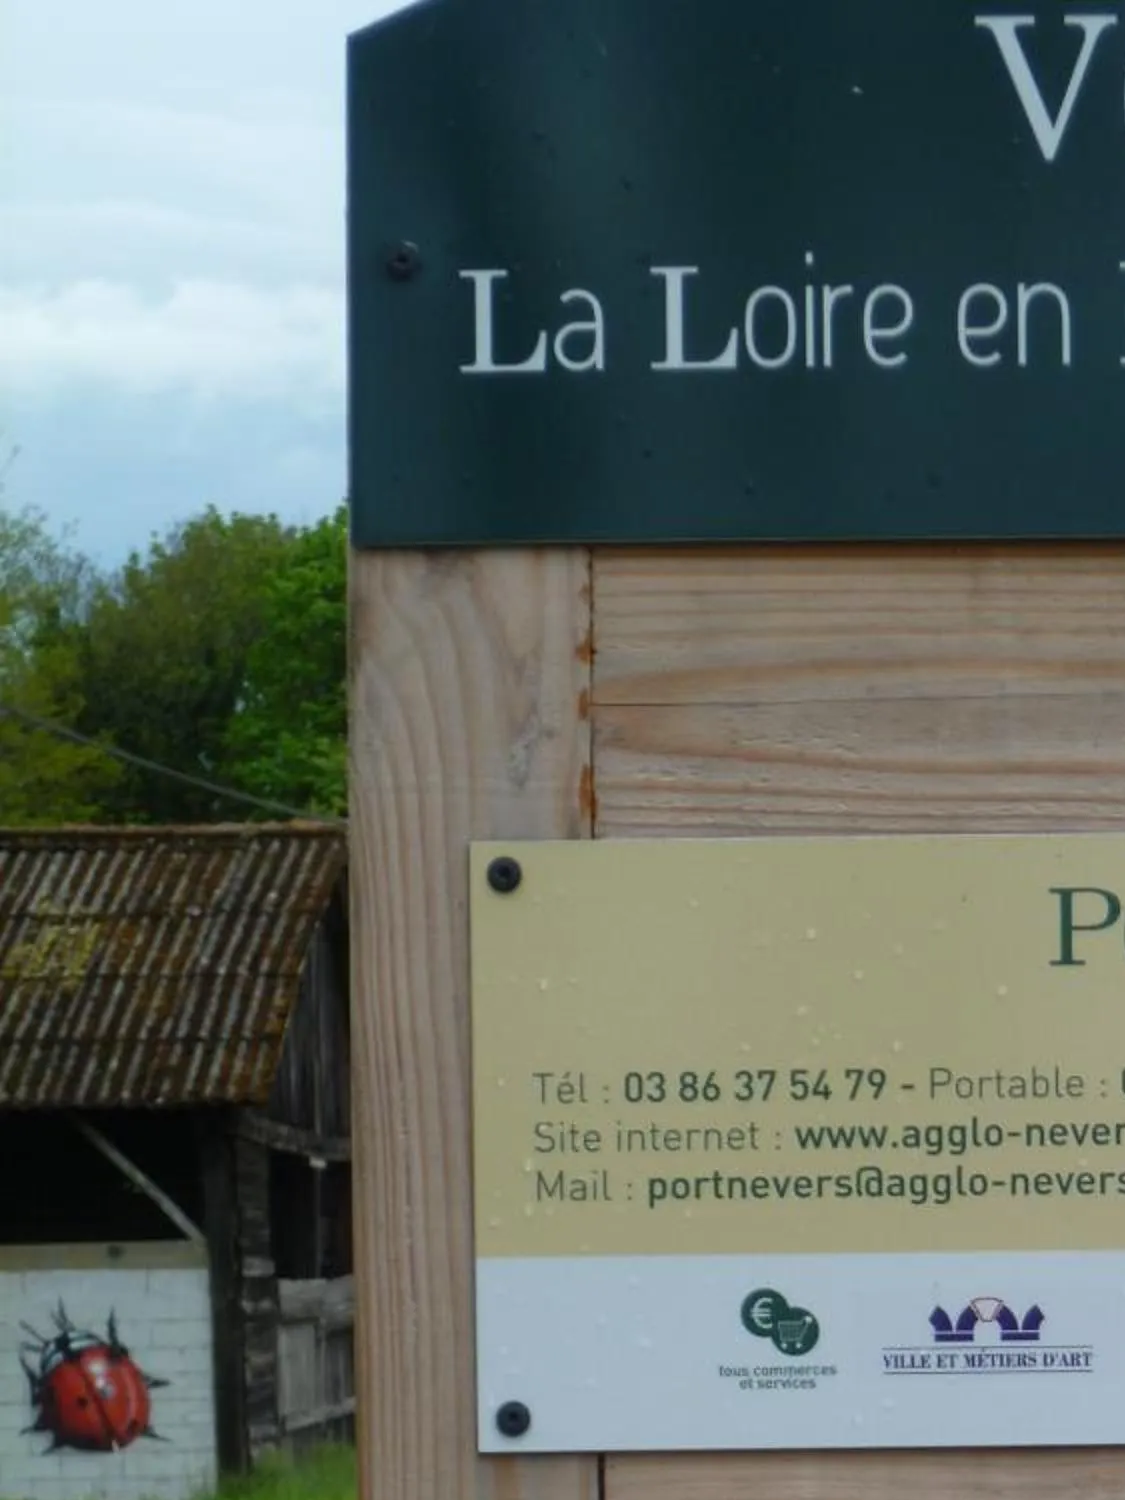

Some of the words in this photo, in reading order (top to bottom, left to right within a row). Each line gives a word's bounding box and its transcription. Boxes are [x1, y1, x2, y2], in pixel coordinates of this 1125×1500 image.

[459, 267, 605, 374] La
[650, 251, 916, 373] Loire
[956, 279, 1071, 370] en
[533, 1071, 586, 1104] Tél
[624, 1071, 666, 1102] 03
[679, 1070, 721, 1102] 86
[734, 1069, 777, 1101] 37
[789, 1069, 832, 1100] 54
[845, 1068, 887, 1099] 79
[929, 1065, 1085, 1100] Portable
[534, 1121, 602, 1153] Site
[616, 1119, 760, 1152] internet
[536, 1169, 612, 1202] Mail
[719, 1364, 749, 1377] tous
[753, 1364, 837, 1377] commerces
[883, 1353, 932, 1371] VILLE
[937, 1352, 958, 1370] ET
[964, 1347, 1037, 1369] MÉTIERS
[1043, 1351, 1093, 1368] D'ART
[757, 1377, 817, 1390] services
